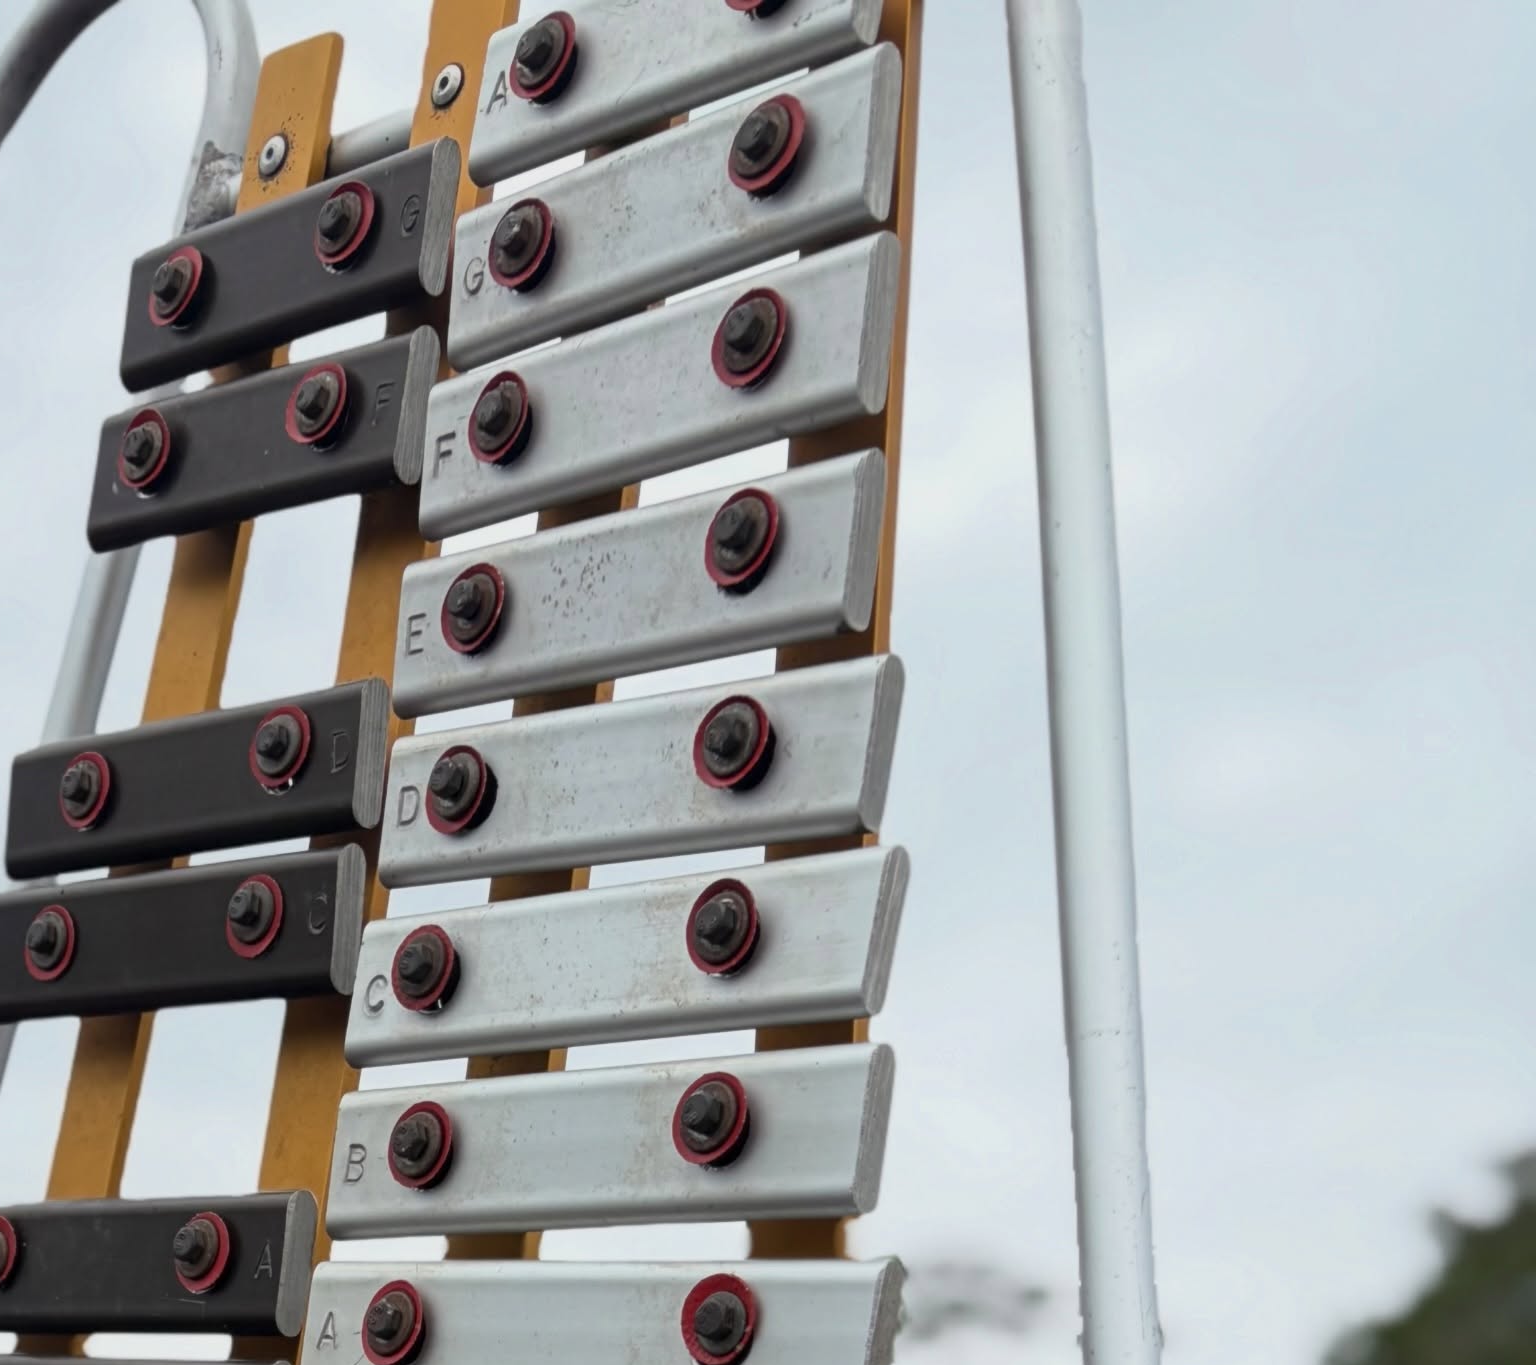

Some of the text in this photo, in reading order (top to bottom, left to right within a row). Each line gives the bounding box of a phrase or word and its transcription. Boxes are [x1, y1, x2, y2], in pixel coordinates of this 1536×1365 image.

[486, 70, 507, 115] A
[401, 195, 420, 237] G
[464, 256, 485, 296] G
[371, 382, 395, 427] F
[433, 431, 456, 479] F
[405, 612, 427, 655] E
[330, 731, 350, 774] D
[396, 785, 420, 828] D
[308, 894, 328, 935] C
[364, 974, 388, 1016] C
[343, 1143, 367, 1185] B
[253, 1241, 273, 1279] A
[316, 1311, 337, 1351] A
